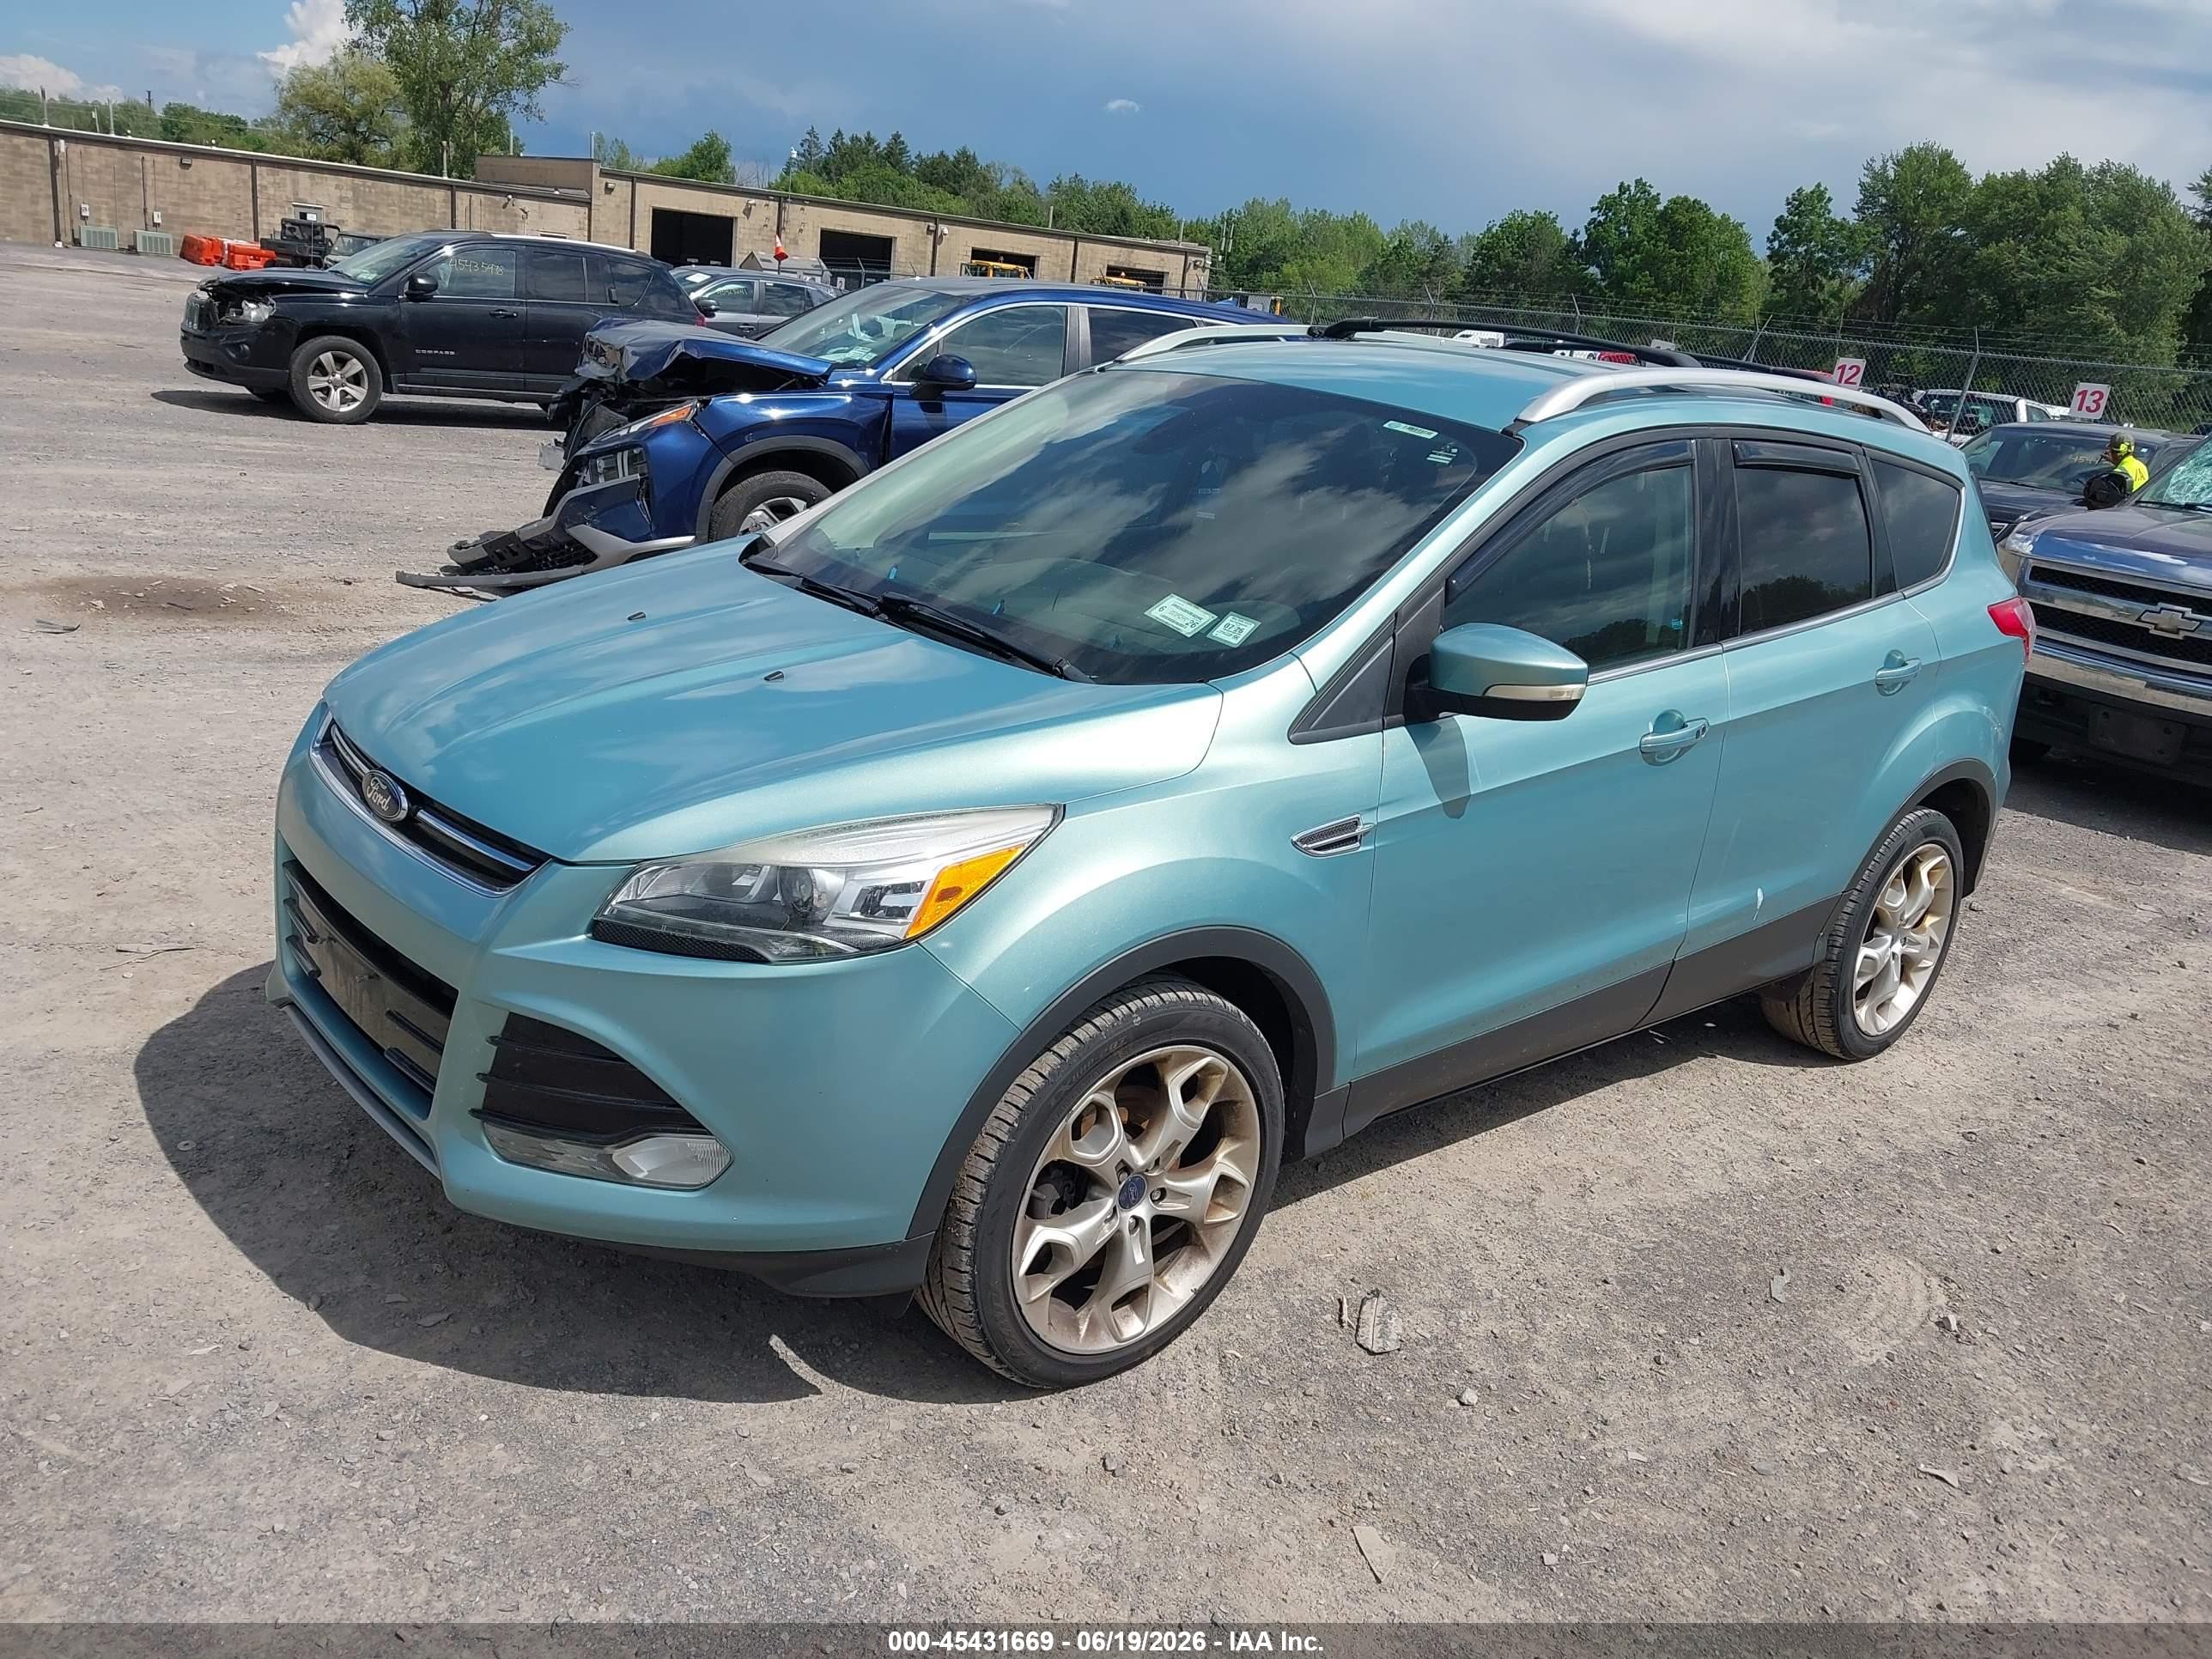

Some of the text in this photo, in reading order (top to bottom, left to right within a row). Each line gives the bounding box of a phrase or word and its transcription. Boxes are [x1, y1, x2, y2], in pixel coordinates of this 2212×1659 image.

[1837, 364, 1861, 385] 12
[2077, 389, 2104, 413] 13
[367, 776, 391, 811] Ford
